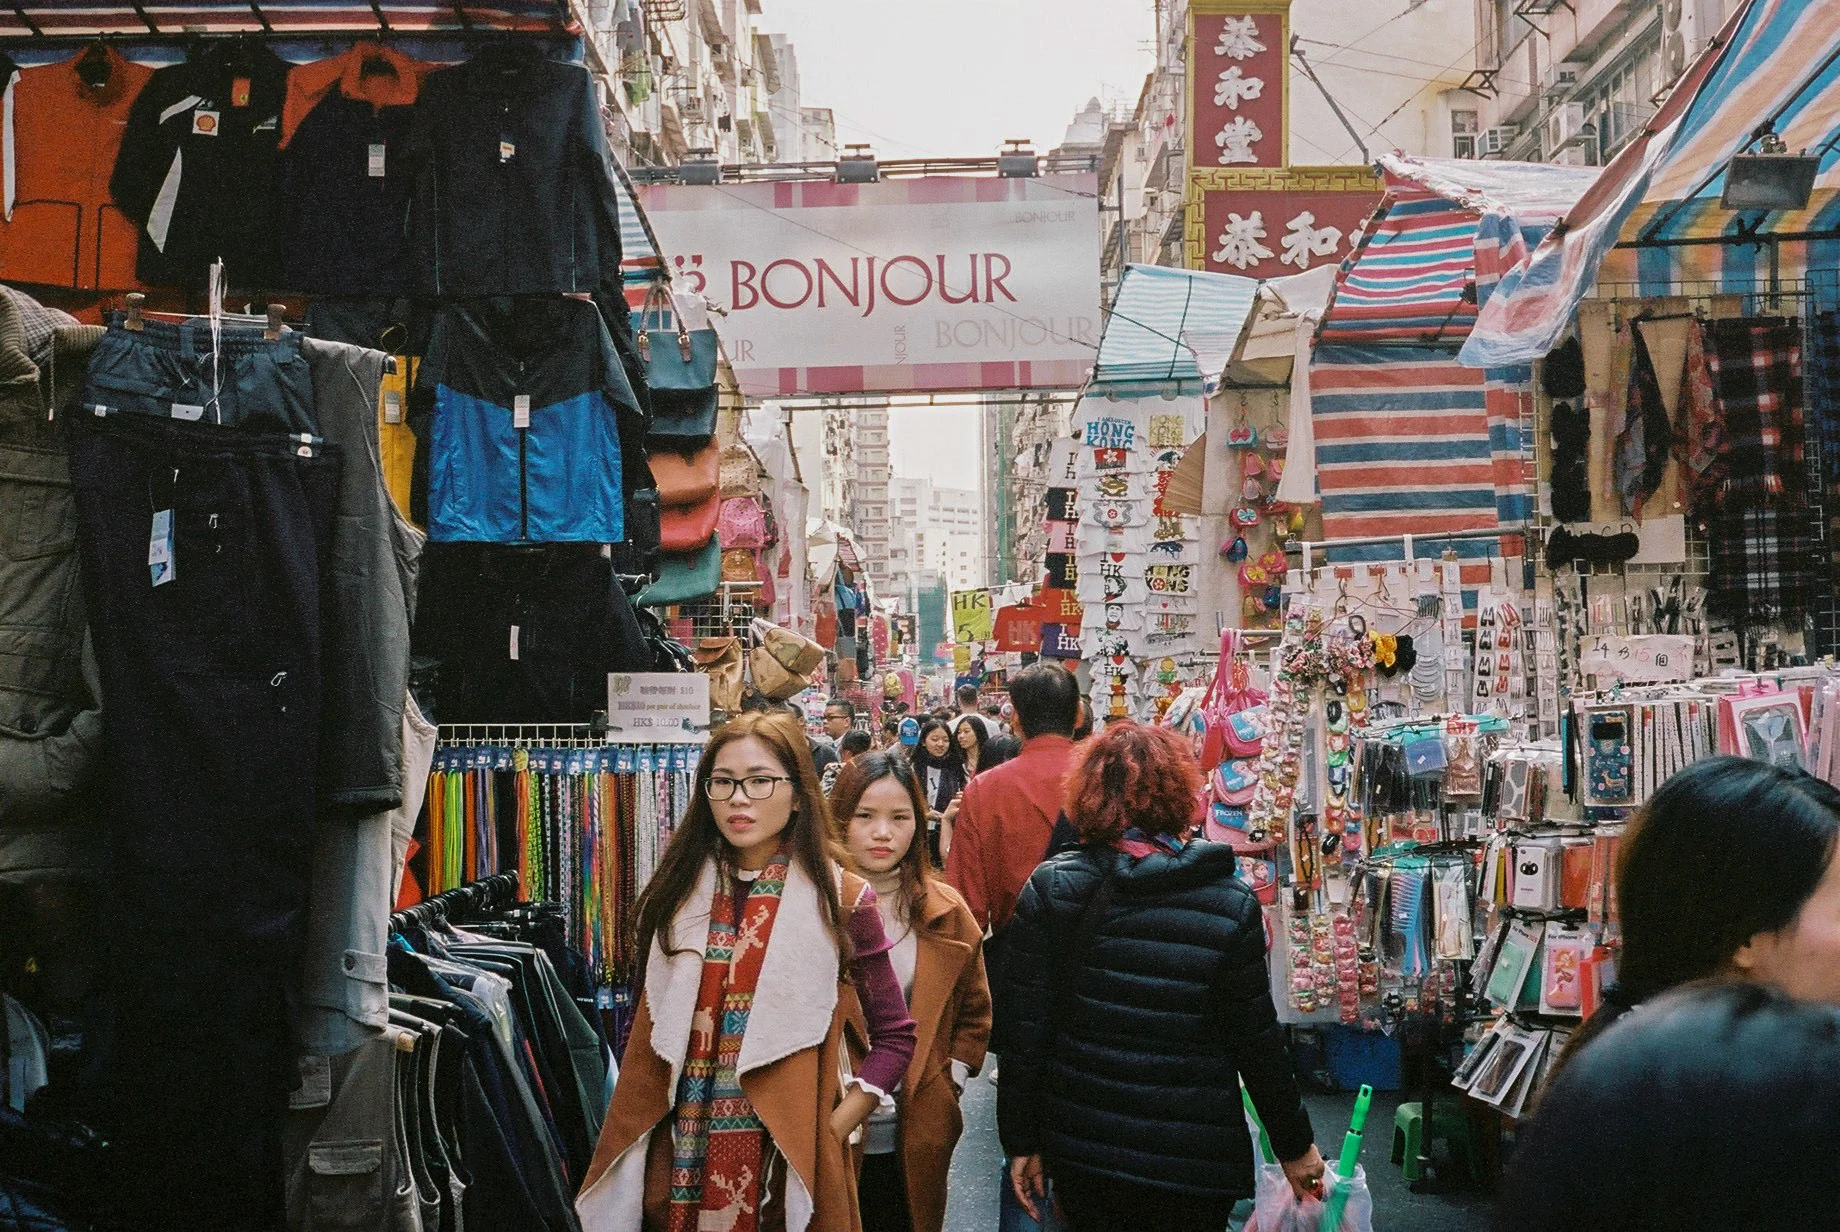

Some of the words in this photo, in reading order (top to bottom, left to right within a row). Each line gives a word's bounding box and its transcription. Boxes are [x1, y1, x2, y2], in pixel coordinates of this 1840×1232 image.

[1015, 211, 1076, 224] BONJOUR
[1212, 210, 1368, 270] 恭和
[730, 253, 1018, 318] BONJOUR
[936, 316, 1095, 351] BONJOUR
[1087, 421, 1135, 439] HONG
[1087, 435, 1133, 450] KONG
[1066, 491, 1075, 505] I
[1066, 523, 1074, 535] I
[1066, 554, 1075, 567] I
[1100, 552, 1108, 563] I
[1100, 564, 1123, 577] HK
[1061, 588, 1070, 602] I
[954, 594, 985, 610] HK
[1060, 603, 1082, 616] HK
[958, 623, 974, 642] 5
[1059, 623, 1068, 636] I
[1057, 636, 1079, 650] HK
[1104, 667, 1124, 676] HK
[633, 717, 653, 728] HK$
[1215, 809, 1243, 817] FROZEN
